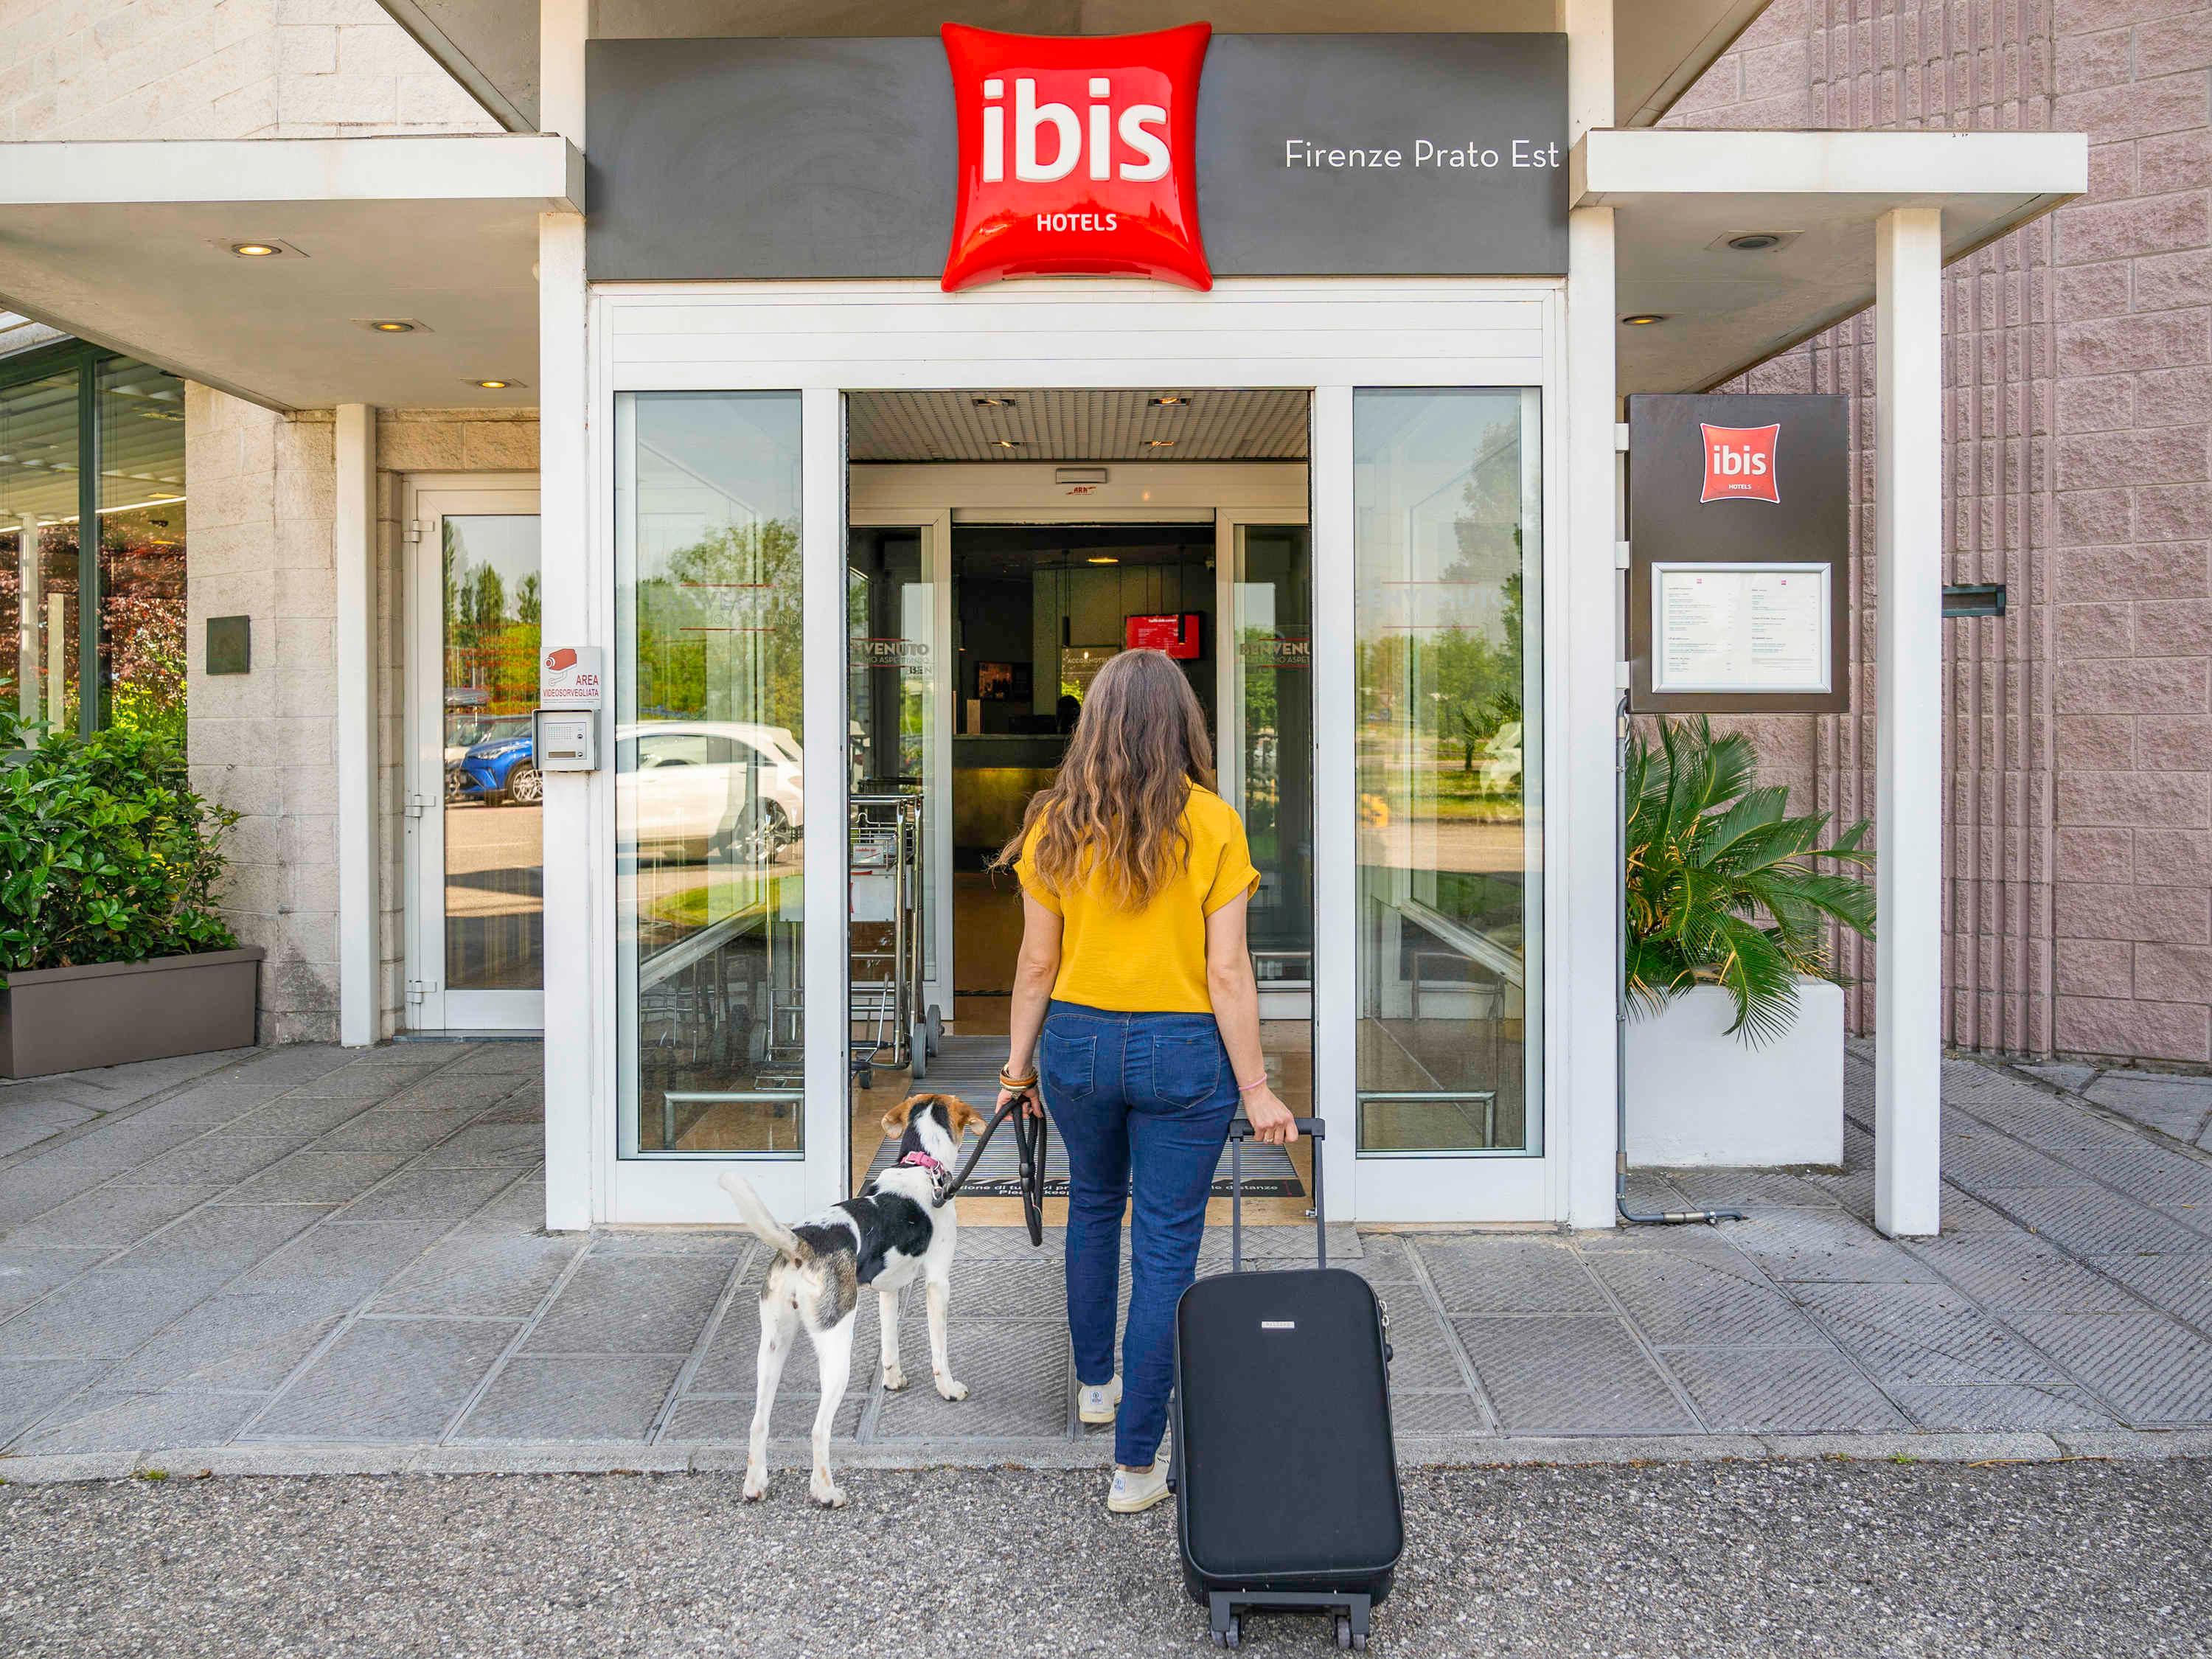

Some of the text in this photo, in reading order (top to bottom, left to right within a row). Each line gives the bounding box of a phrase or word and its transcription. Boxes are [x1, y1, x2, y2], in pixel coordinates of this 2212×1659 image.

[983, 77, 1171, 183] ibis
[1286, 139, 1559, 168] Firenze Prato Est
[1037, 213, 1117, 232] HOTELS
[1713, 445, 1767, 476] ibis
[576, 674, 599, 686] AREA
[543, 688, 599, 697] VIDEOSORVEGLIATA
